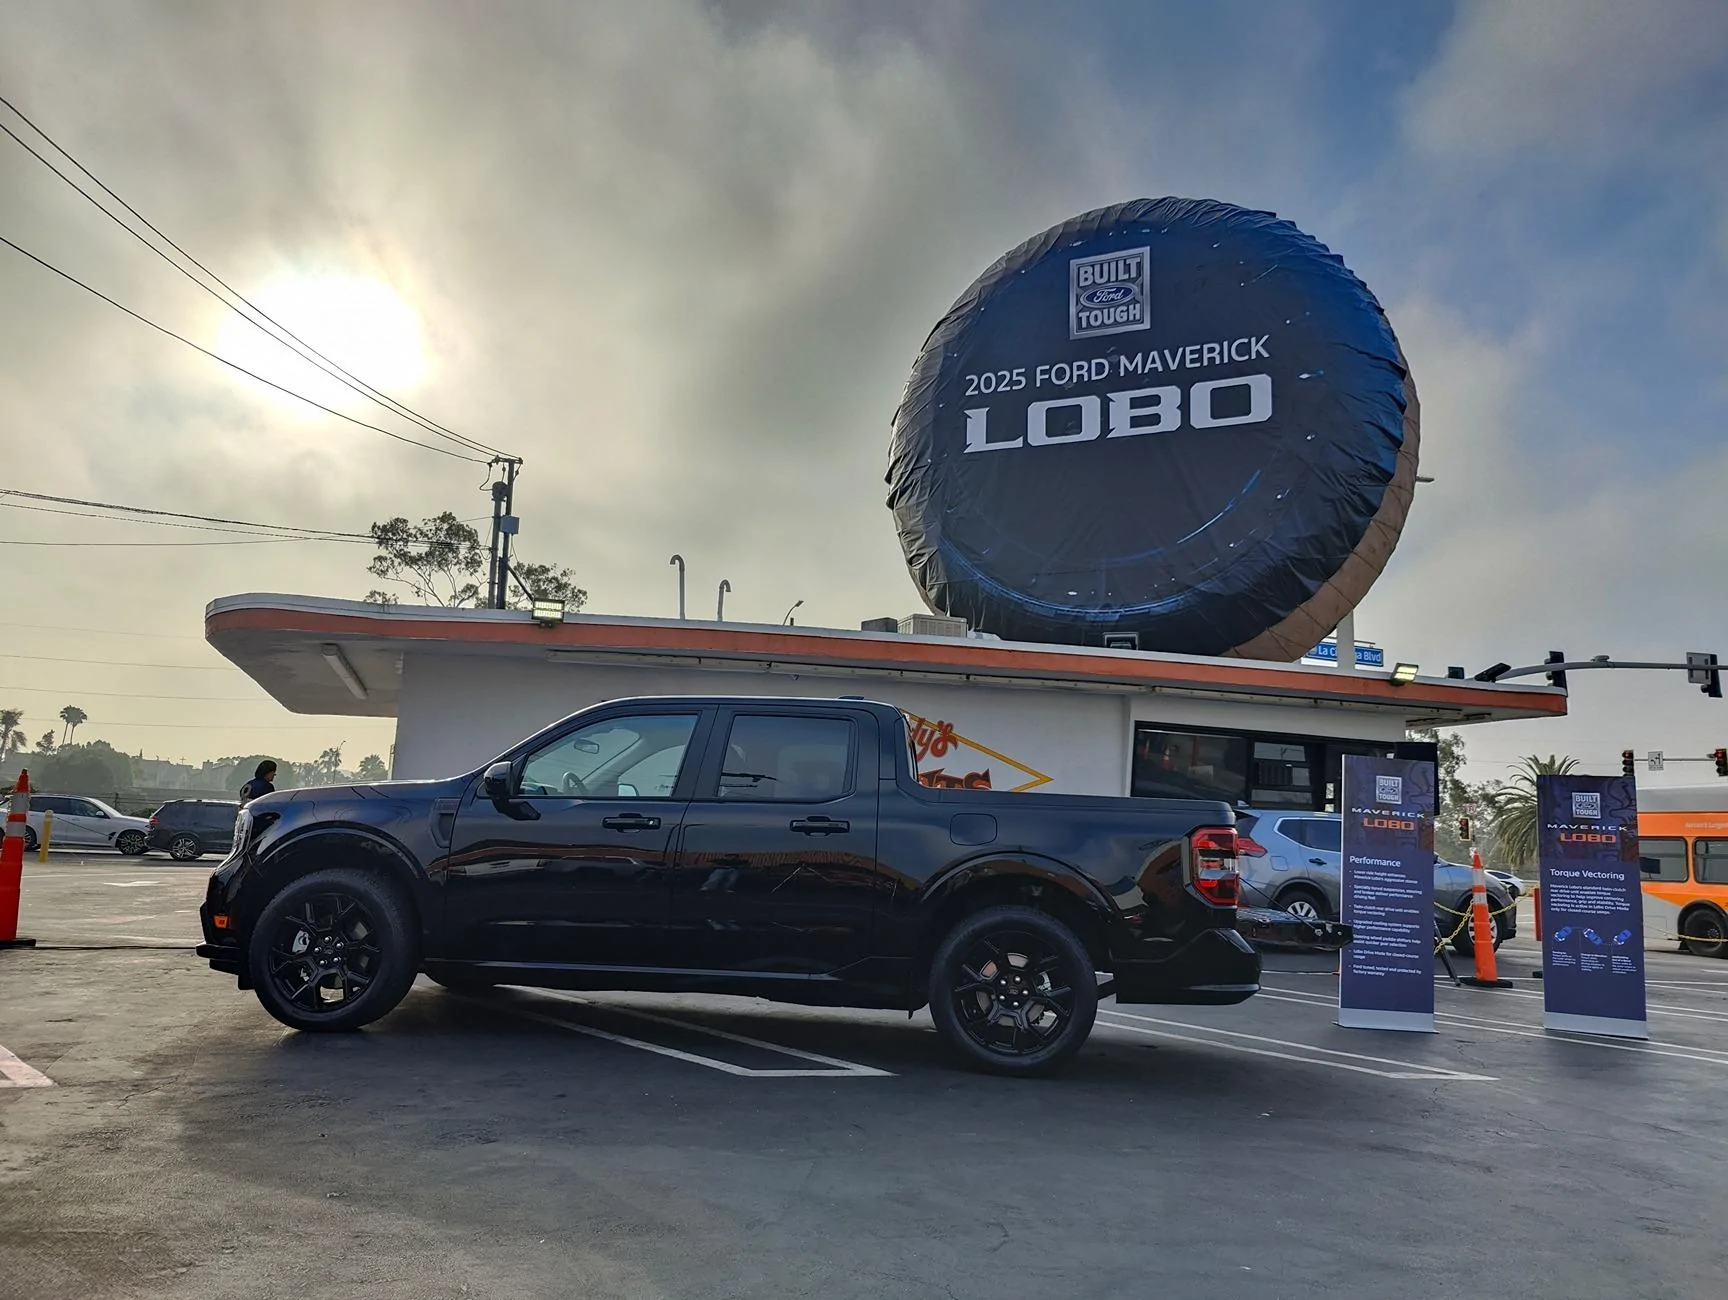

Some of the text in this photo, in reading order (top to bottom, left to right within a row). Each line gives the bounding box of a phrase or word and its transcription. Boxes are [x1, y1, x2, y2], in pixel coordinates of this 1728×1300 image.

[1079, 257, 1141, 287] BUILT
[1093, 287, 1124, 303] Ford
[1079, 303, 1141, 329] TOUGH
[965, 334, 1270, 396] 2025 FORD MAVERICK
[963, 373, 1273, 454] LOBO
[1318, 646, 1328, 656] La
[1364, 651, 1382, 662] Blvd
[1379, 779, 1398, 787] BUILT
[1379, 793, 1399, 801] TOUGH
[1575, 795, 1597, 803] BUILT
[1352, 807, 1425, 818] MAVERICK
[1363, 818, 1415, 831] LOBO
[1547, 823, 1627, 832] MAVERICK
[1560, 833, 1616, 843] LOBO
[1349, 855, 1401, 867] Performance
[1550, 868, 1625, 881] Torque Vectoring
